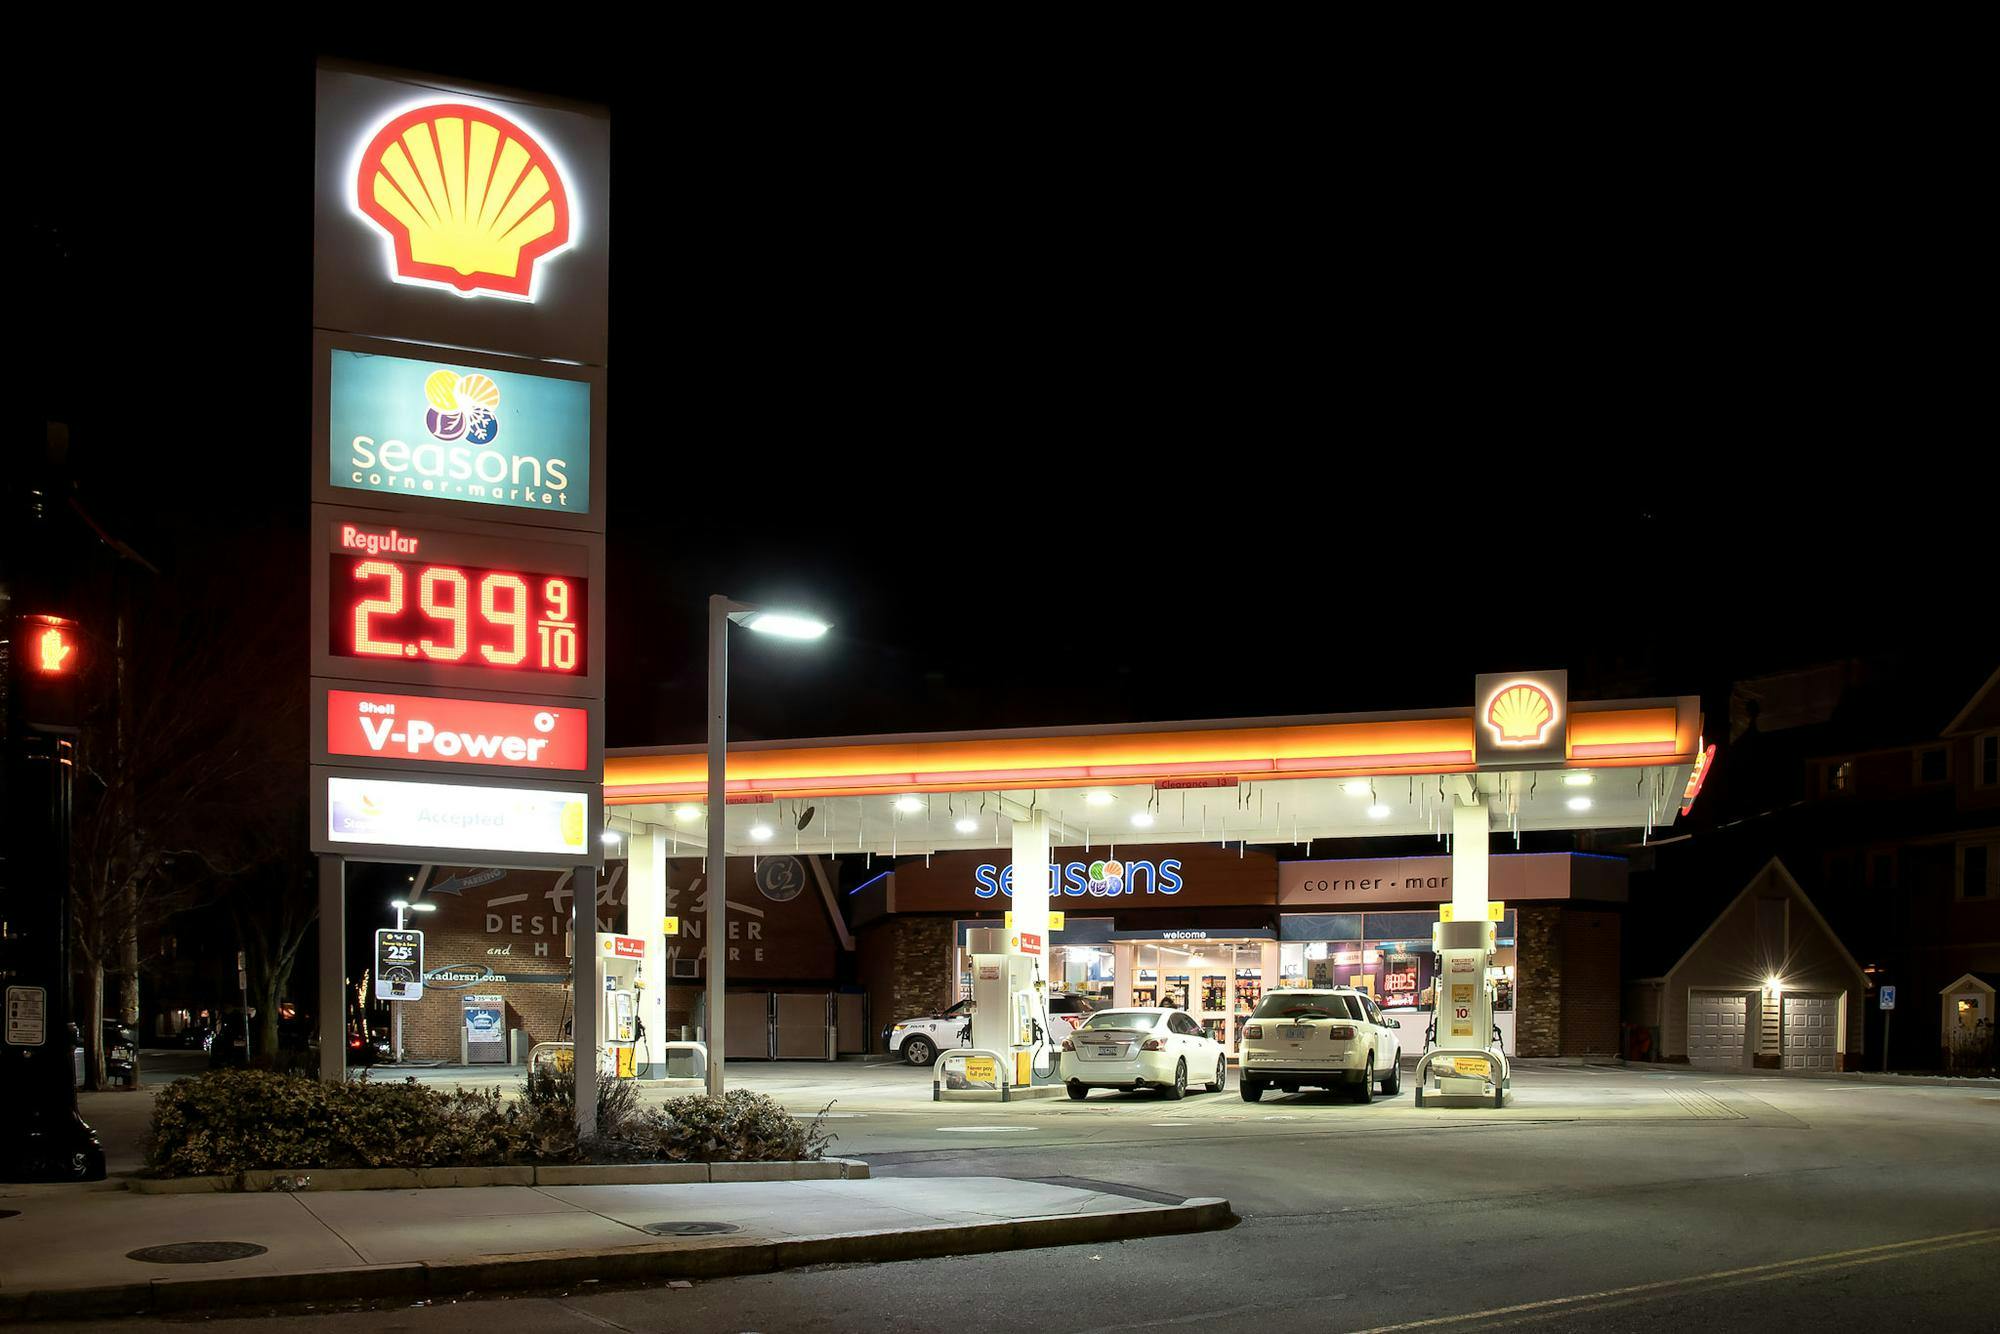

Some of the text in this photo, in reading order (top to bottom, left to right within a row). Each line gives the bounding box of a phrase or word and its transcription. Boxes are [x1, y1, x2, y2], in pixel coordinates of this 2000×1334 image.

[352, 435, 569, 490] seasons
[352, 472, 568, 505] corner market
[343, 526, 418, 554] Regular
[355, 562, 527, 664] 2.99
[359, 701, 395, 715] Shell
[359, 716, 546, 761] V-Power
[1304, 876, 1449, 892] corner mar
[1163, 931, 1207, 939] welcome
[487, 944, 512, 955] and
